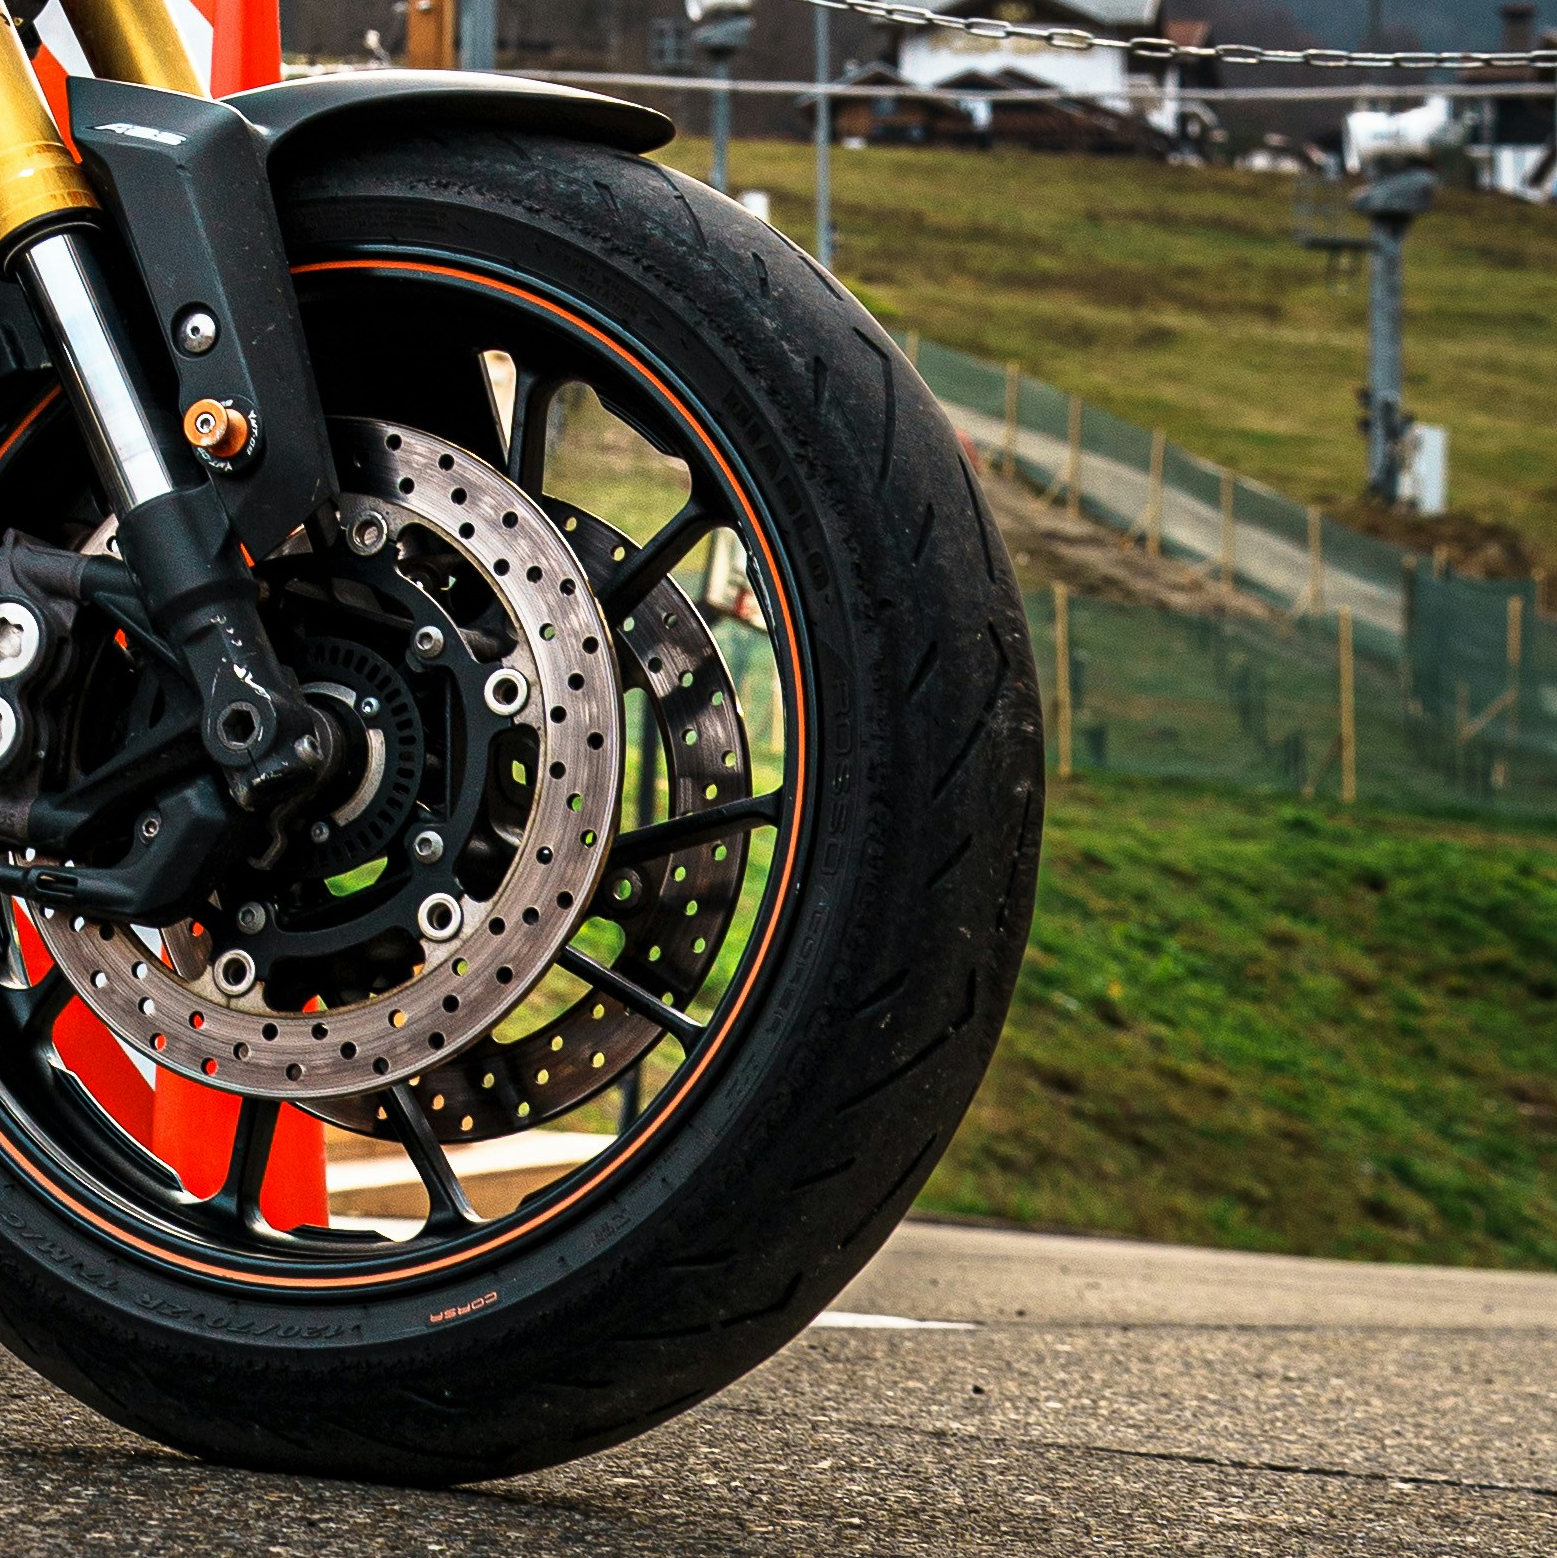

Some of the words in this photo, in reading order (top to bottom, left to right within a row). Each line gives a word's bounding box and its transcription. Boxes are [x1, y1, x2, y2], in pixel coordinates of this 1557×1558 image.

[92, 122, 187, 146] ABS
[720, 385, 832, 594] DIABLO
[819, 678, 853, 878] ROSSO
[428, 1290, 499, 1325] CORSA
[201, 1314, 348, 1342] 120/70
